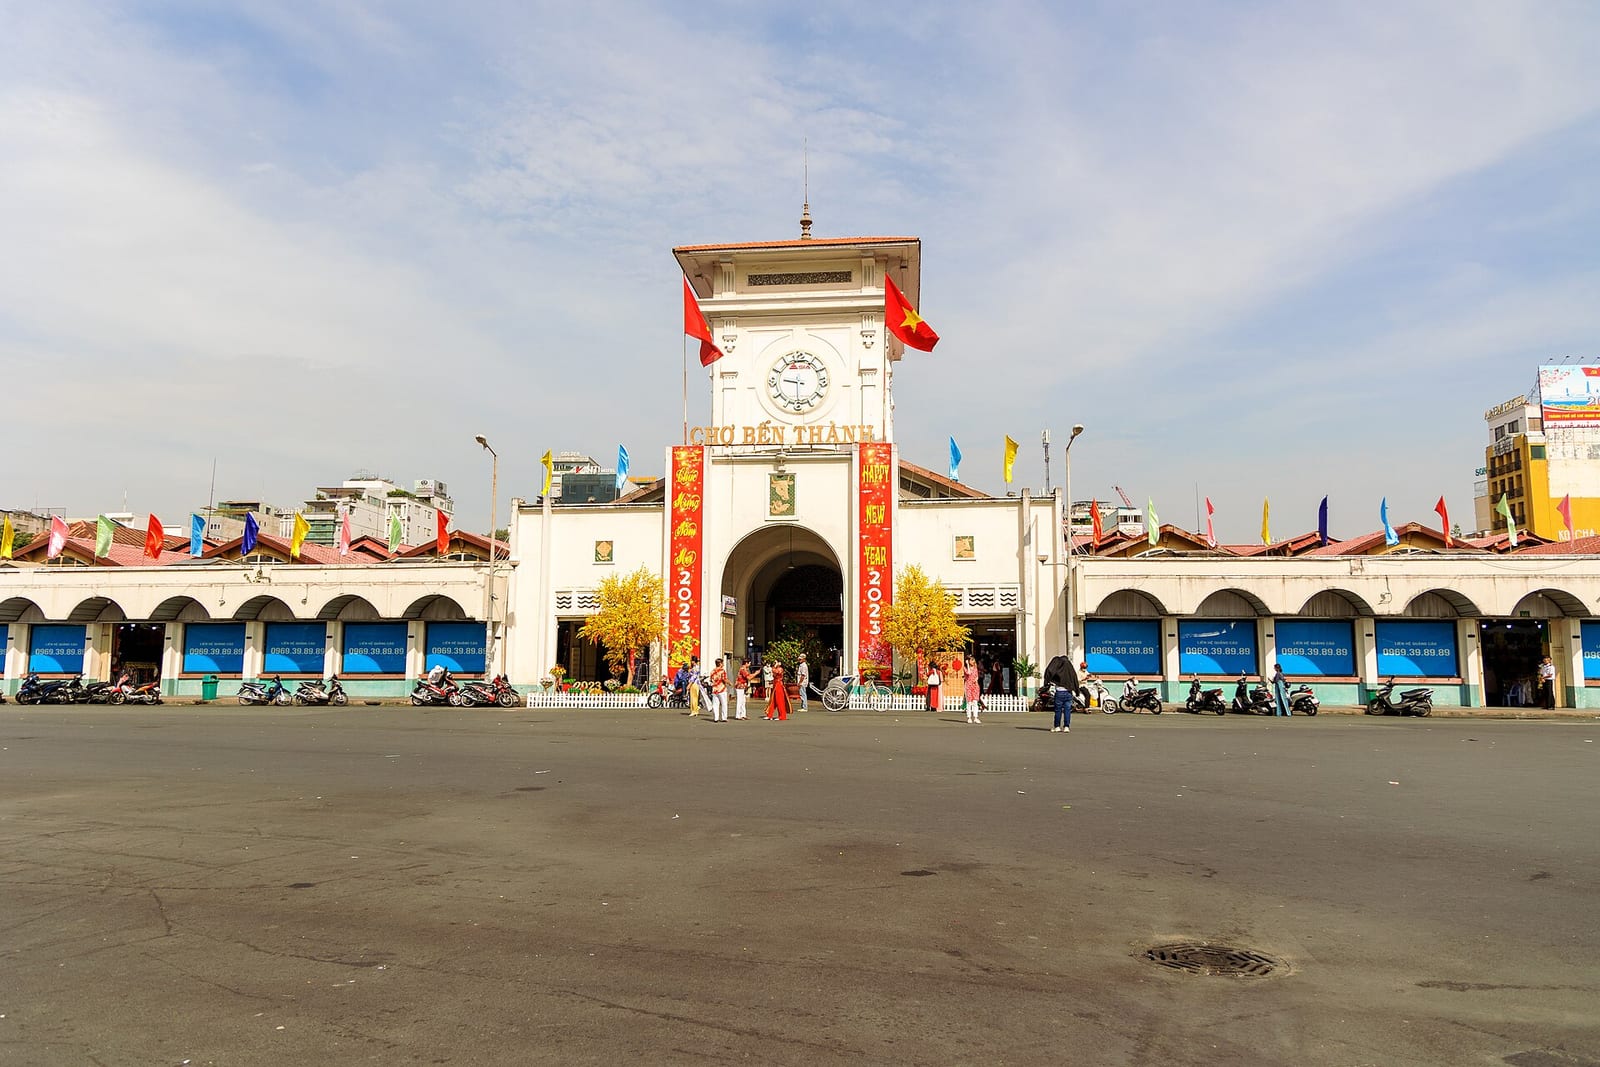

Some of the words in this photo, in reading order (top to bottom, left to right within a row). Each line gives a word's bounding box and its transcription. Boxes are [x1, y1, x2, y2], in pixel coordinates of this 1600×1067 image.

[690, 424, 735, 447] CHỢ
[742, 420, 785, 445] BẾN
[793, 420, 875, 444] THÀNH
[862, 464, 889, 483] HAPPY
[865, 505, 885, 524] NEW
[864, 546, 887, 567] YEAR
[678, 571, 692, 634] 2023
[867, 571, 882, 635] 2023
